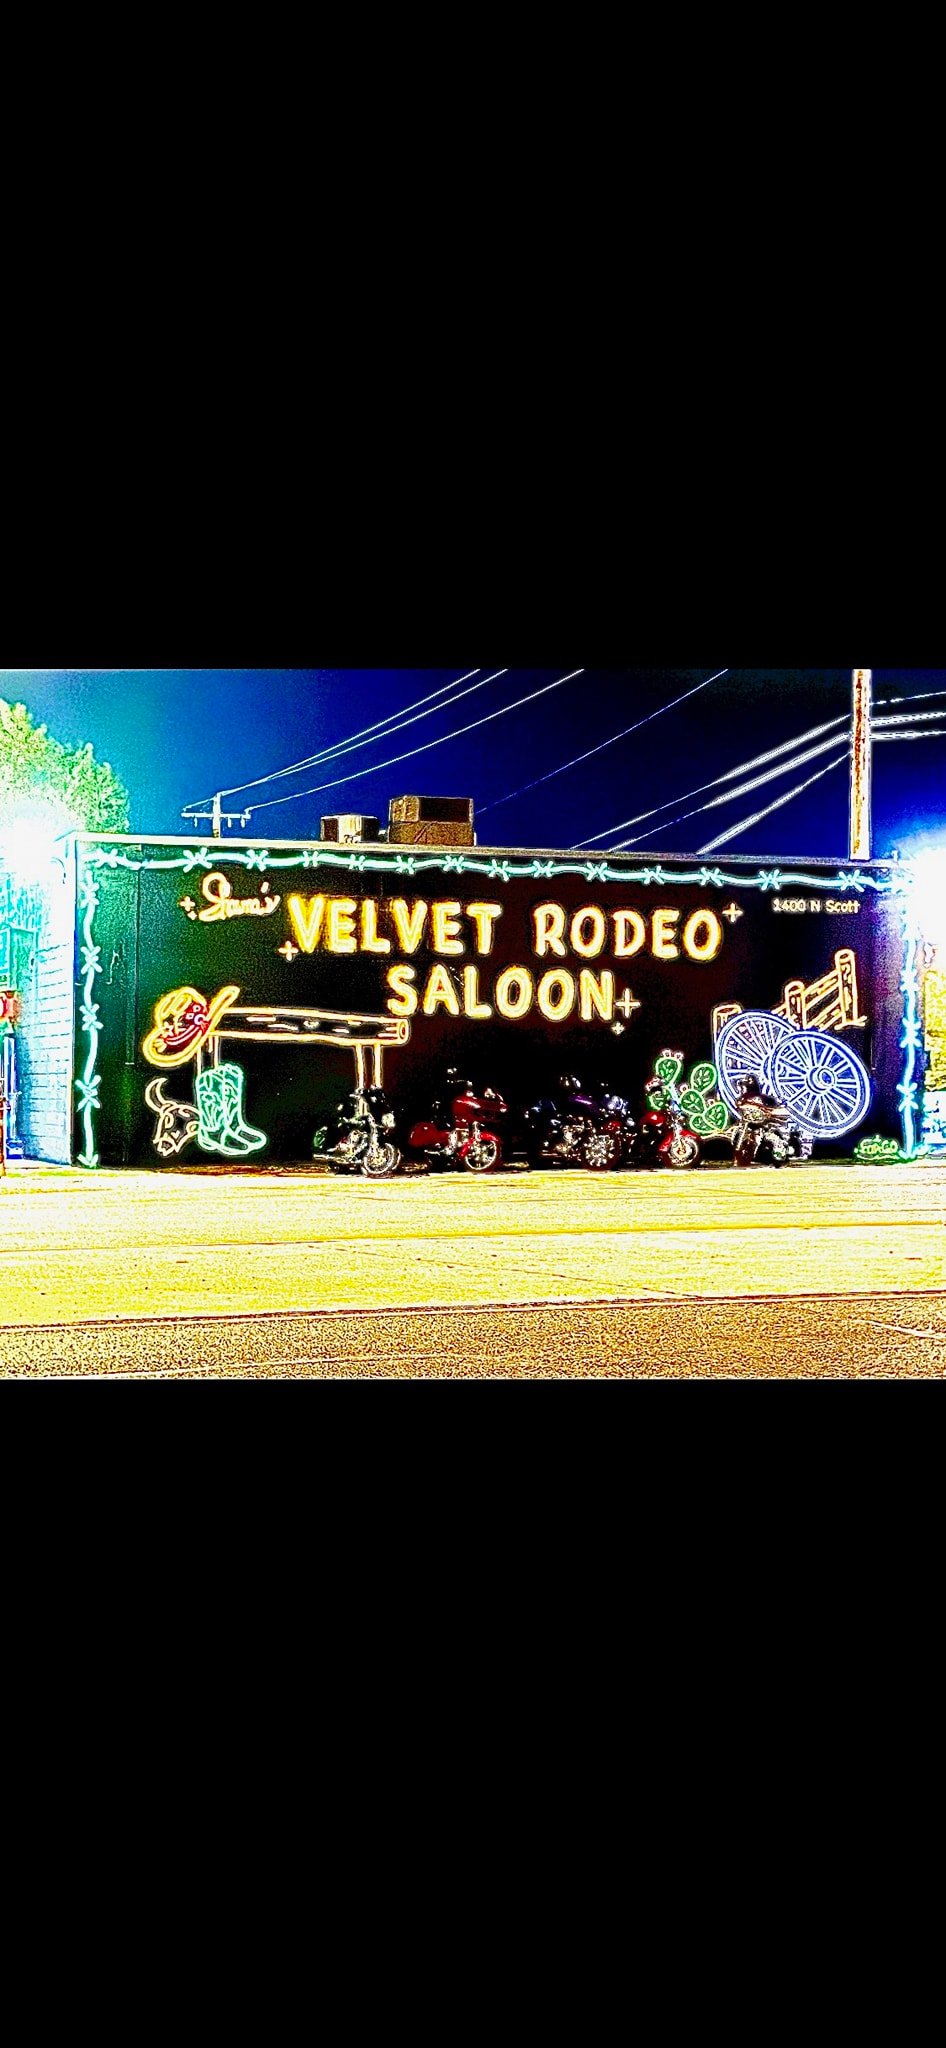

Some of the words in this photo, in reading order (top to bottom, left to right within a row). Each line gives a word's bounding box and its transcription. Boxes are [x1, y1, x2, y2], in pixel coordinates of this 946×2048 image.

[287, 894, 502, 955] VELVET
[533, 903, 723, 962] RODEO
[773, 898, 806, 912] 1400
[810, 899, 821, 912] N
[825, 899, 860, 913] Scott
[387, 964, 614, 1021] SALOON
